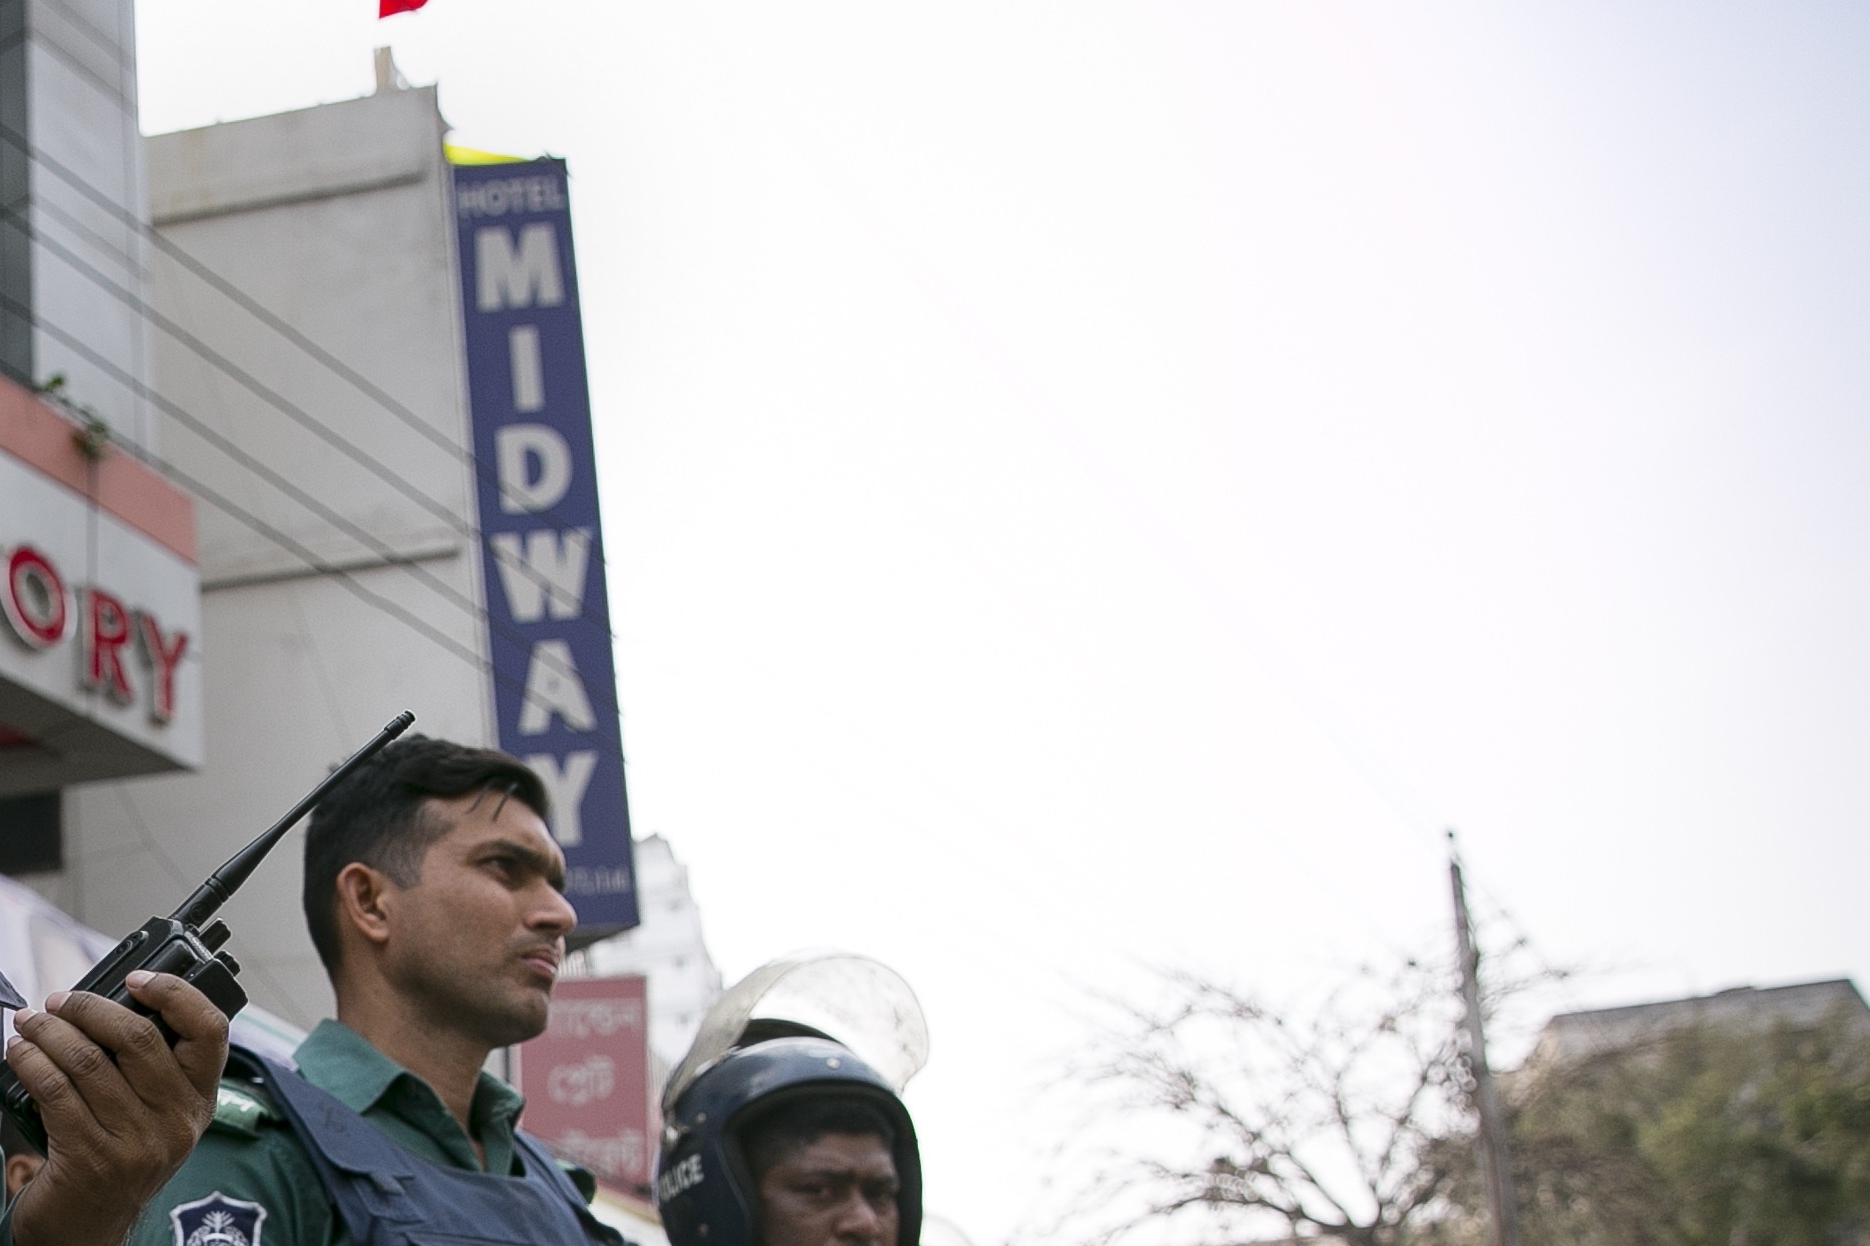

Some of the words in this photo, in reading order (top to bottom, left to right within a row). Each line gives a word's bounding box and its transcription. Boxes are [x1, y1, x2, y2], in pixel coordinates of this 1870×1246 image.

[457, 172, 564, 222] HOTEL
[474, 222, 600, 848] MIDWAY
[658, 1152, 705, 1202] OLICE
